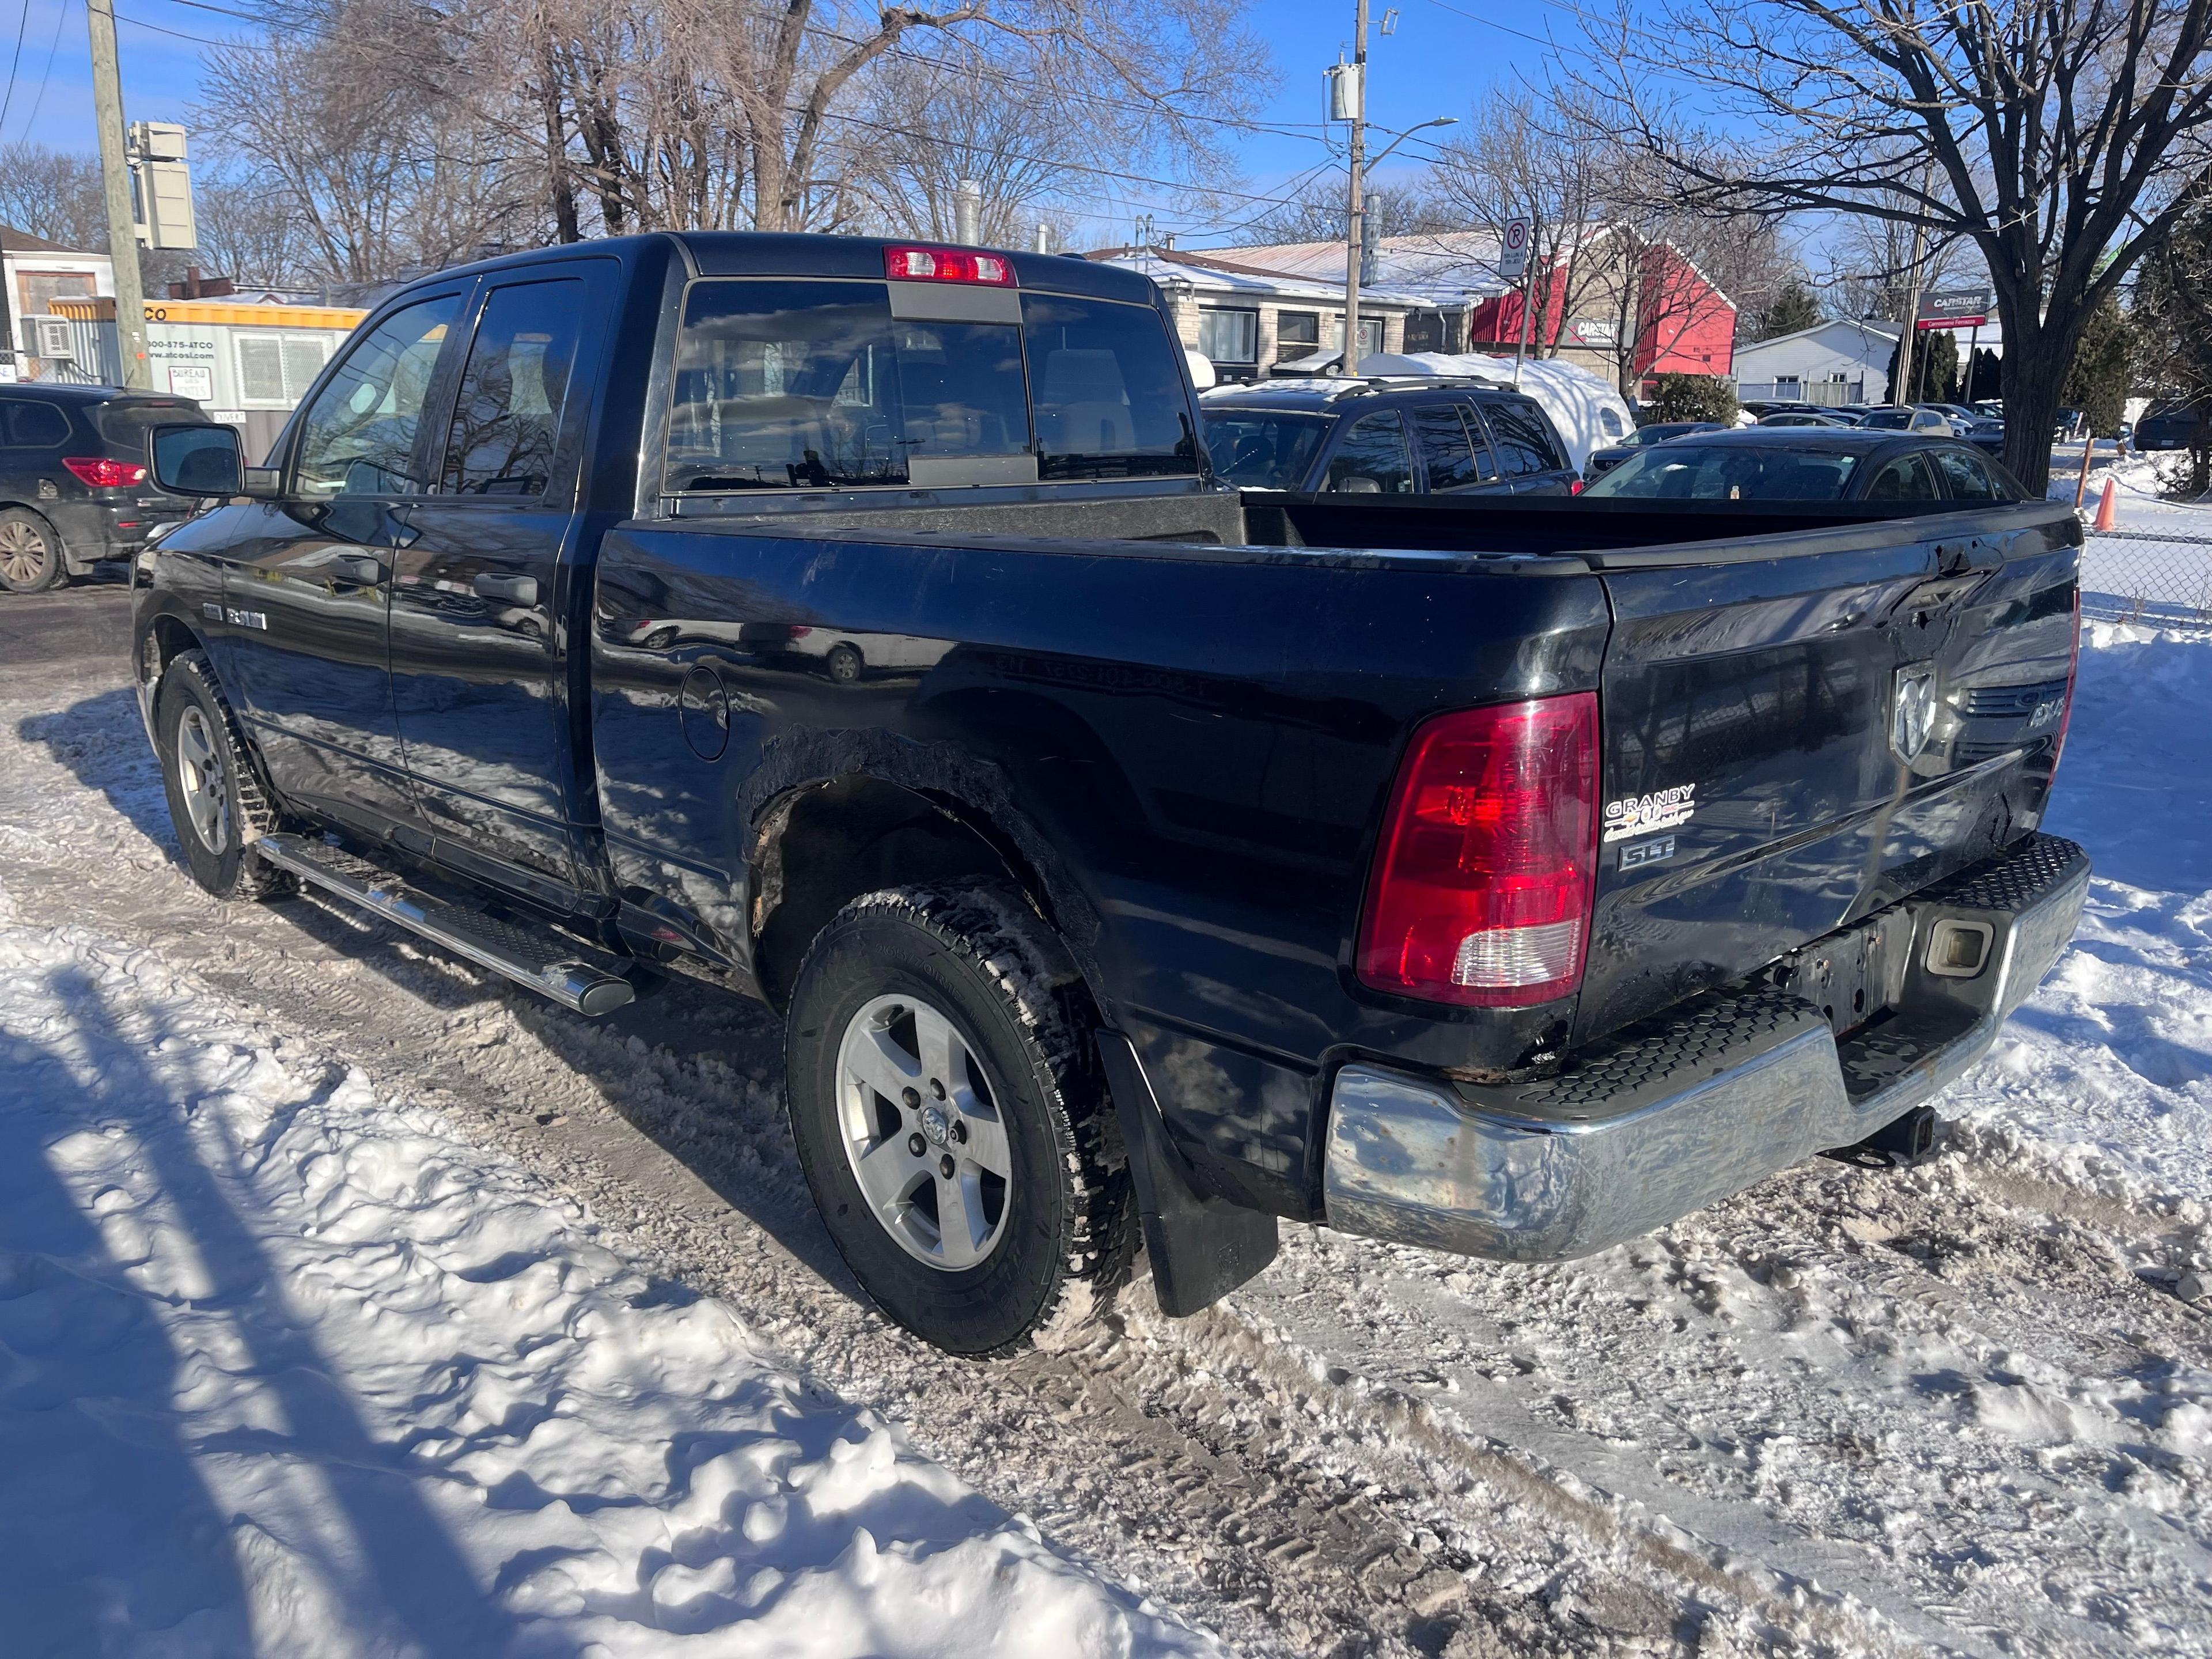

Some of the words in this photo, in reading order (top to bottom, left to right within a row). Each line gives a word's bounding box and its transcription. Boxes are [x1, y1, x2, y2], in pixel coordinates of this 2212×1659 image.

[1934, 296, 1982, 308] CARSTAR
[172, 369, 206, 377] BUREAU
[215, 412, 244, 421] OUVERT
[1605, 783, 1695, 817] GRANBY
[1626, 840, 1670, 865] SLT
